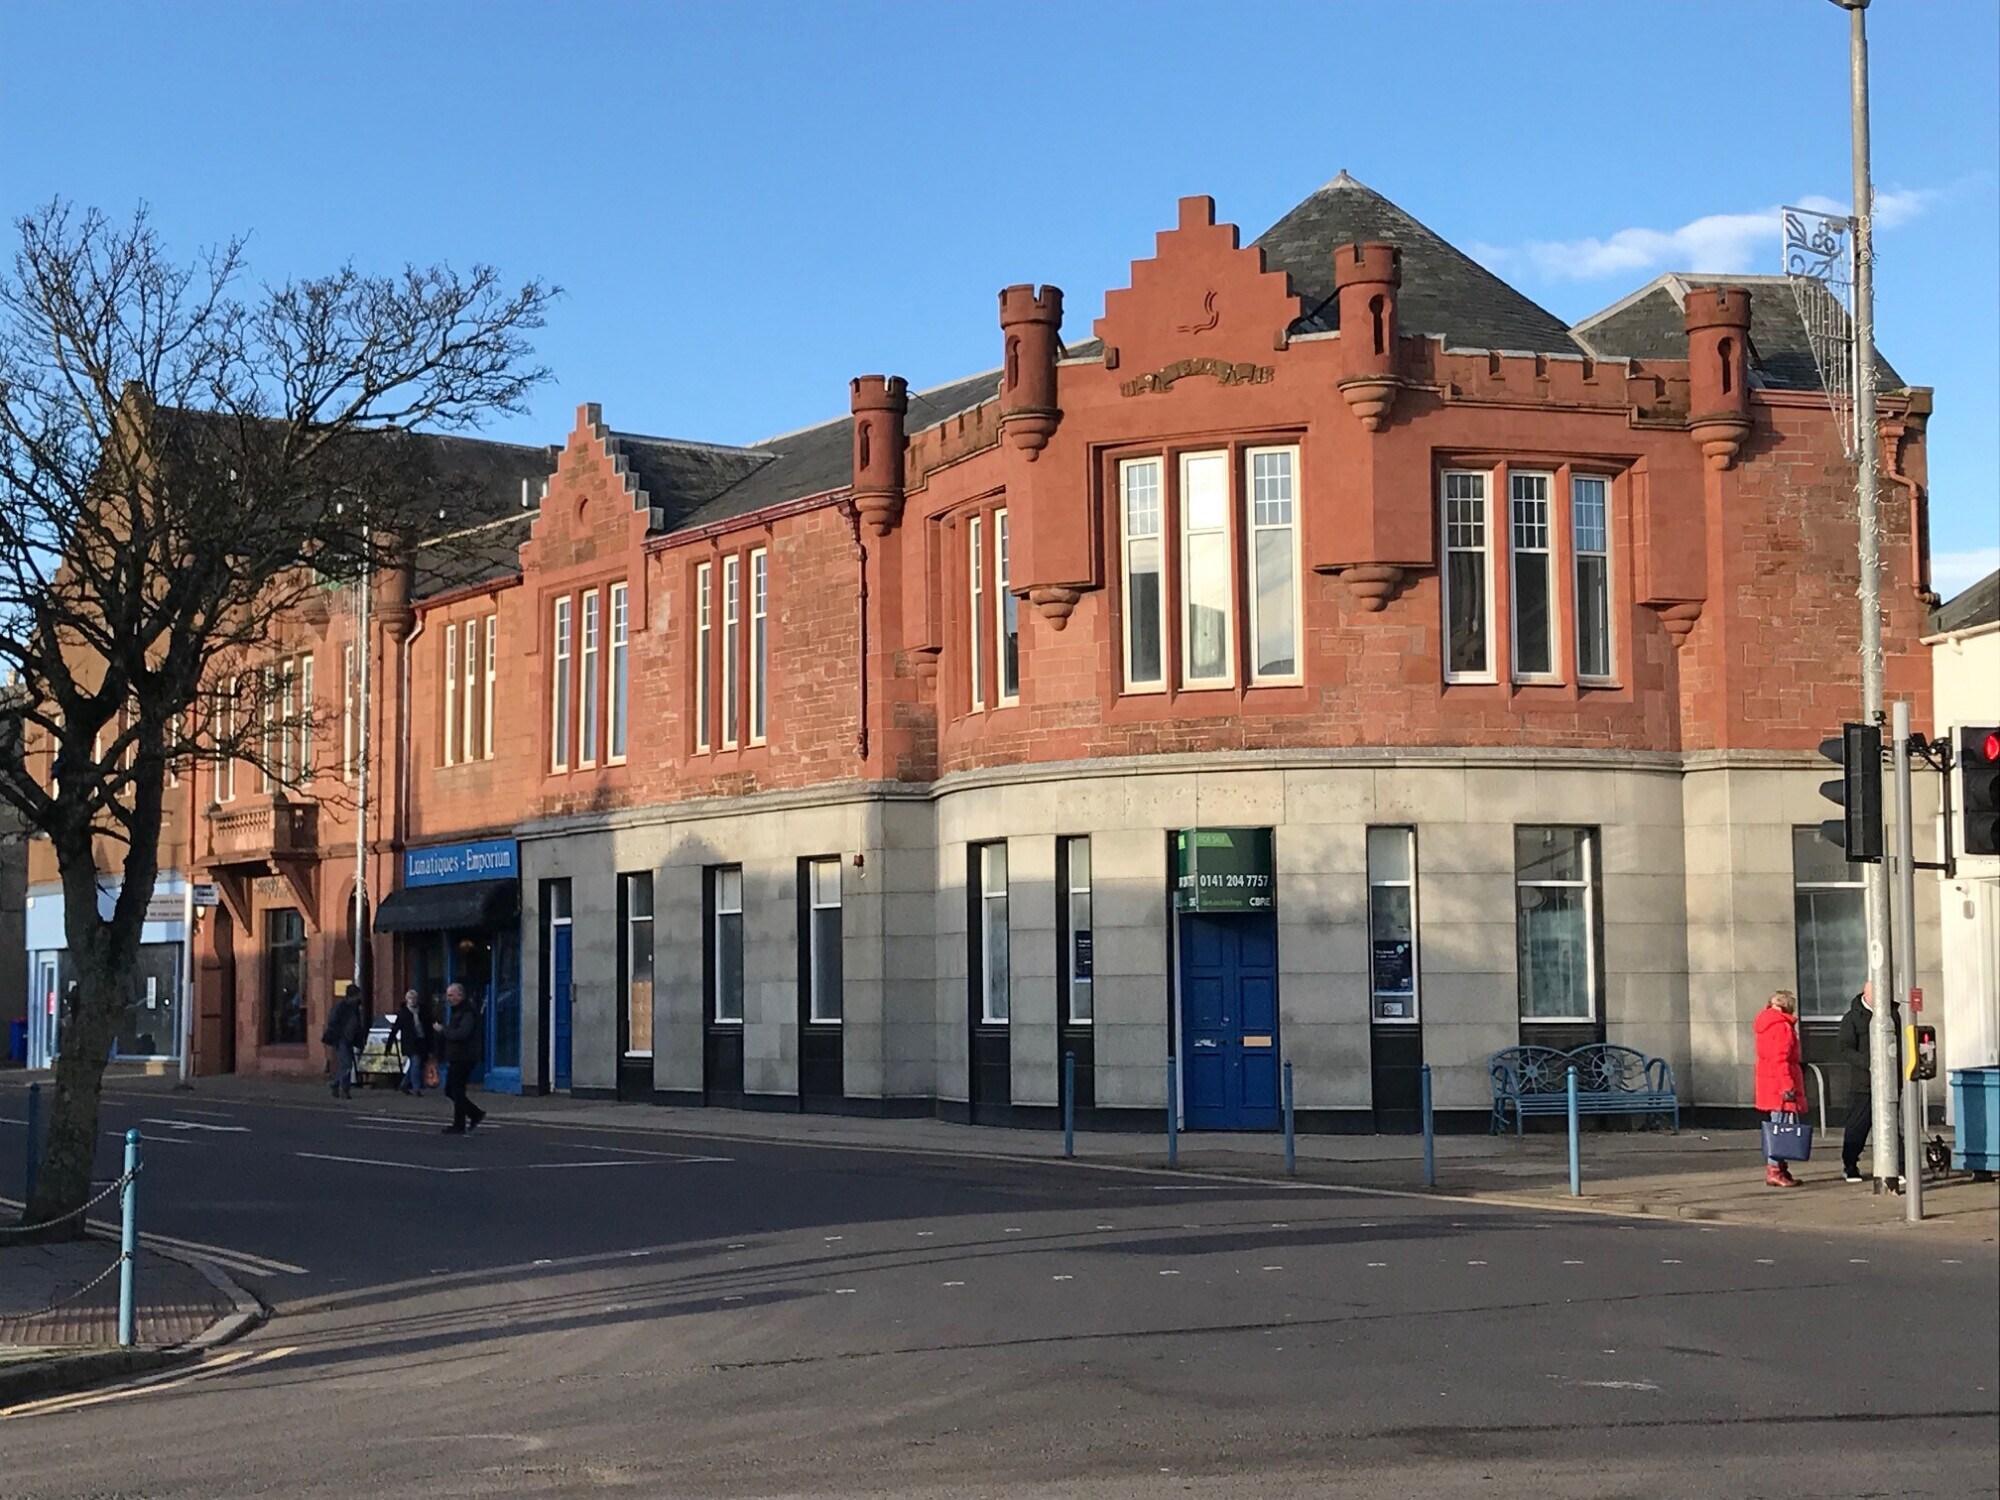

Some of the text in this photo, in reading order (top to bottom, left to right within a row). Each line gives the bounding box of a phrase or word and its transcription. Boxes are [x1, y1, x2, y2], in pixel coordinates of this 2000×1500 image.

[409, 852, 459, 876] Lunatiques
[466, 846, 511, 873] Emporium
[1200, 874, 1223, 887] 0141
[1226, 874, 1245, 887] 204
[1246, 874, 1269, 887] 7757
[1249, 896, 1271, 907] CBRE
